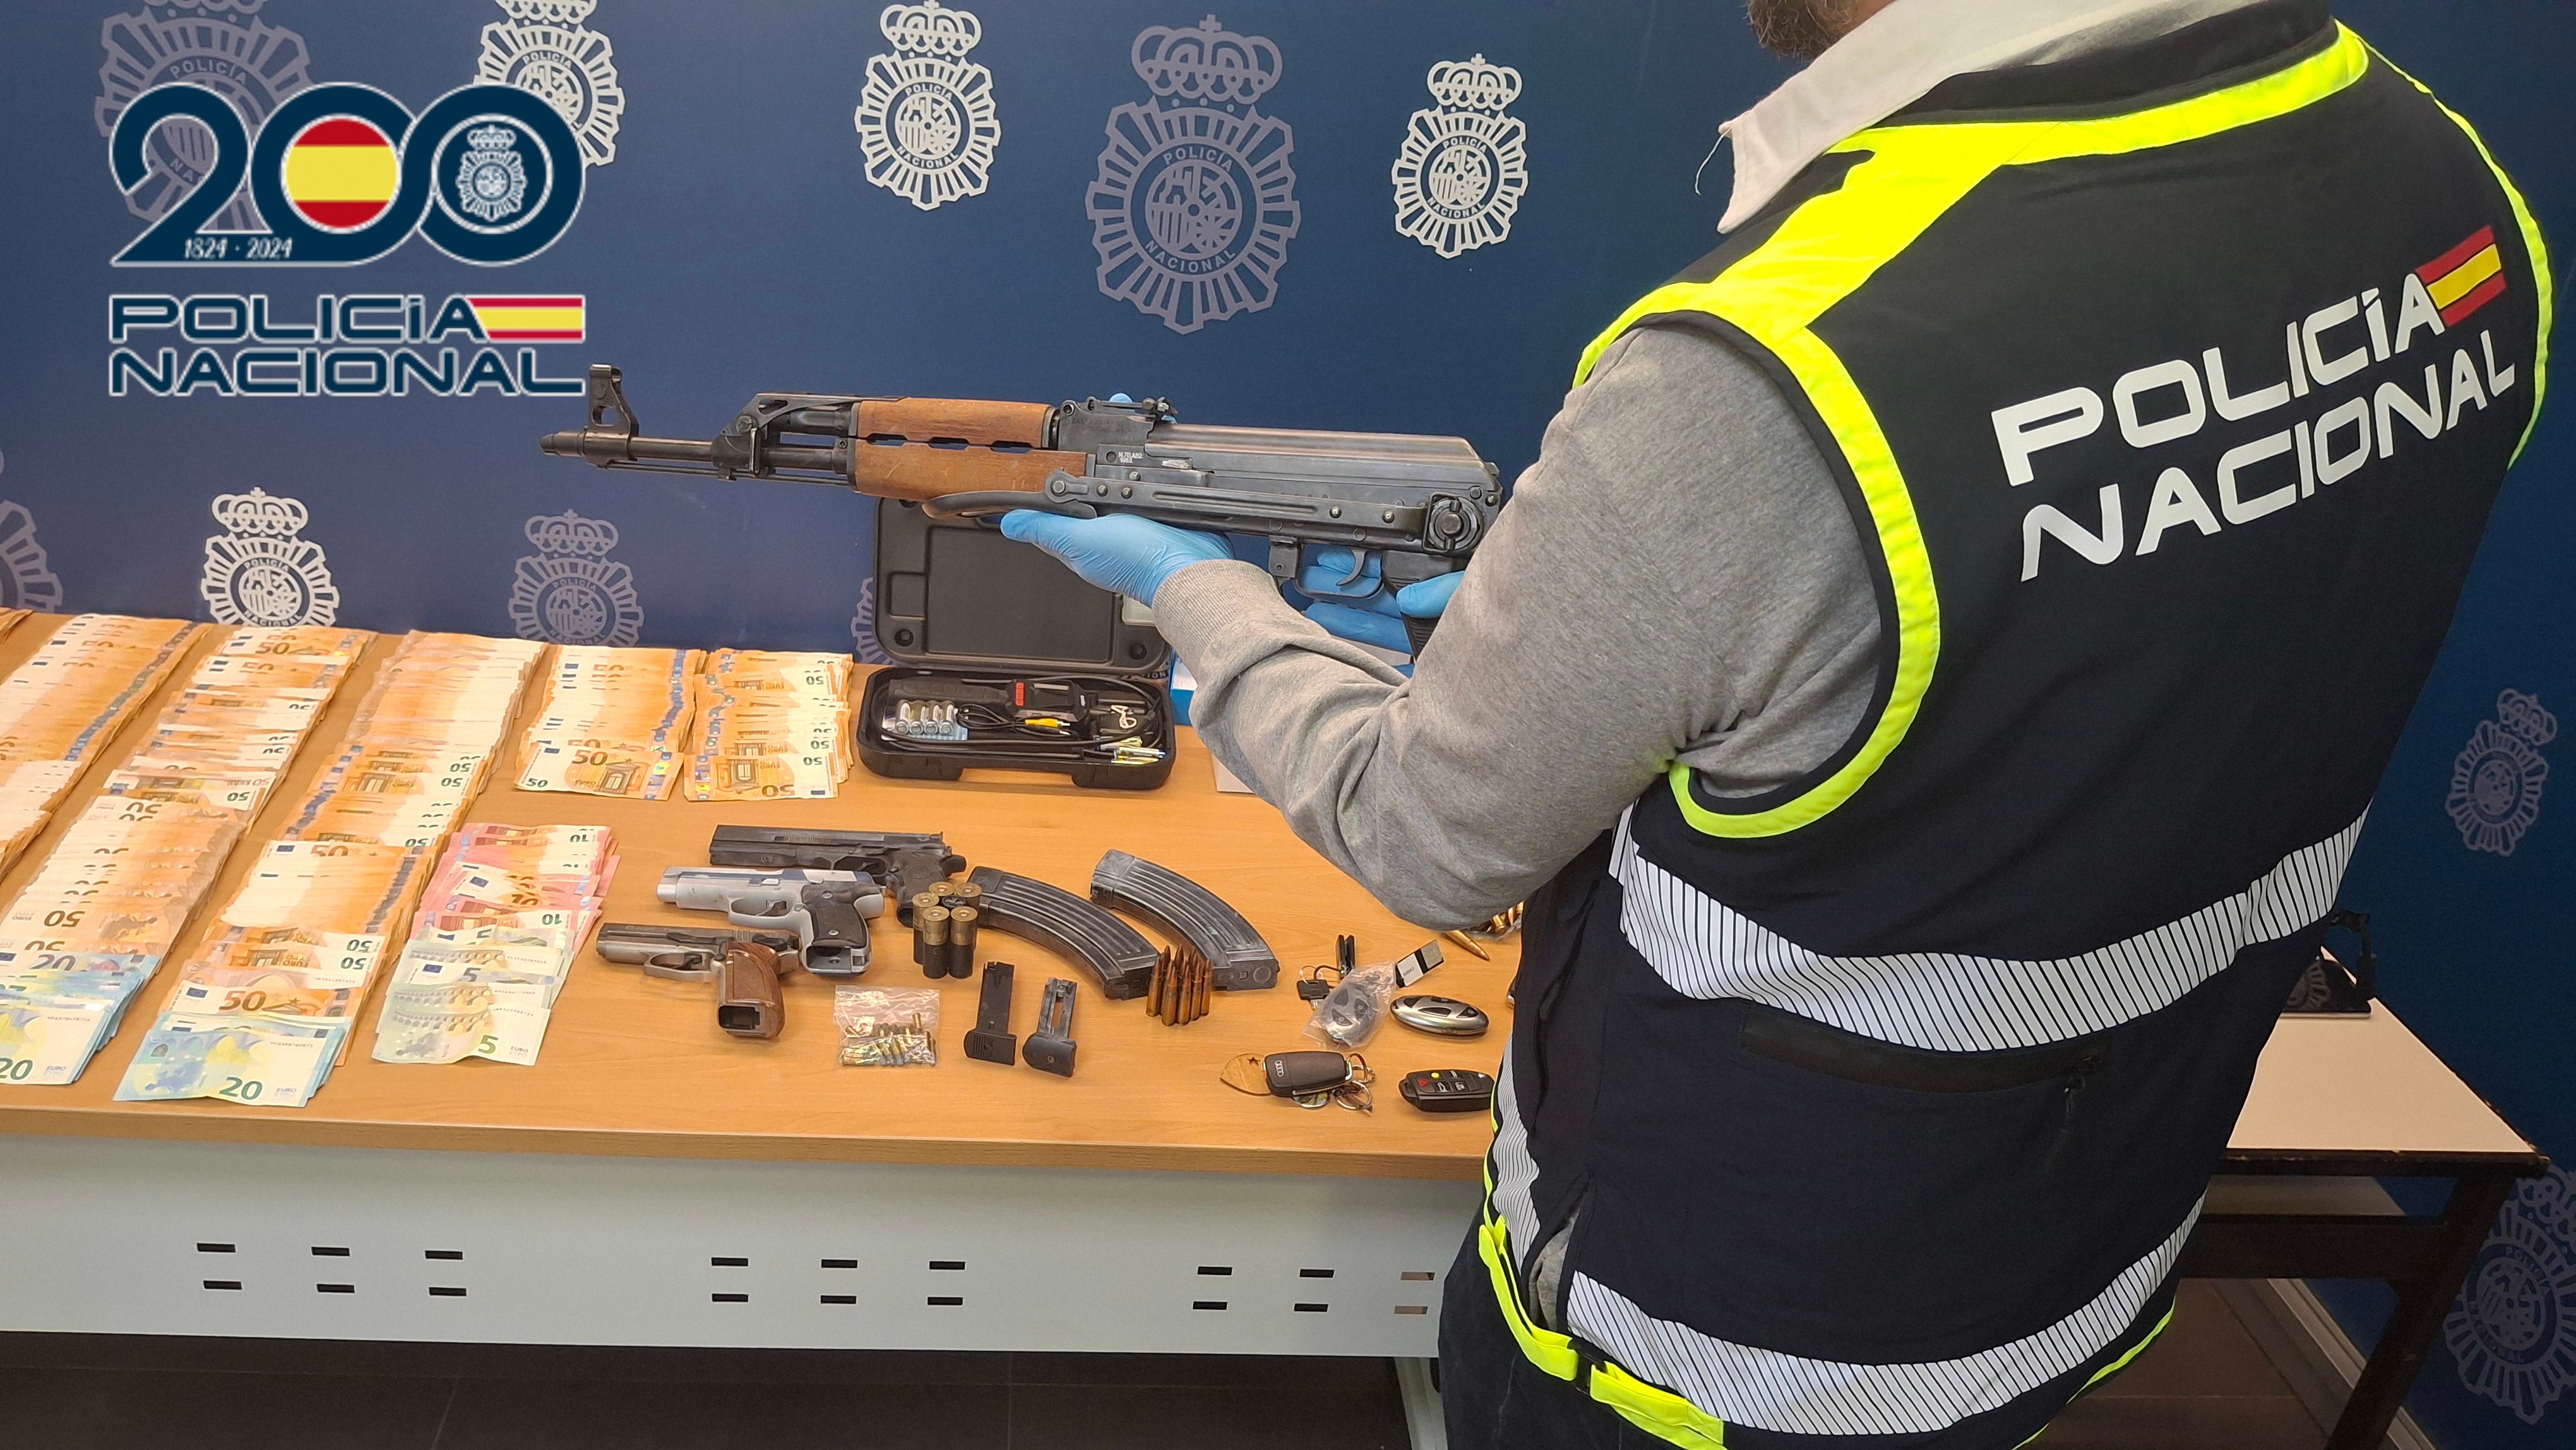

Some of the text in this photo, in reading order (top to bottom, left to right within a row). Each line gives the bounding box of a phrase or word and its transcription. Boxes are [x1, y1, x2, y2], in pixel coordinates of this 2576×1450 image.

[896, 145, 958, 169] NACIONAL
[1427, 196, 1485, 219] NACIONAL
[1144, 240, 1236, 273] NACIONAL
[1991, 273, 2445, 486] POLICÍA
[2021, 330, 2515, 582] NACIONAL
[255, 642, 290, 655] 50
[806, 676, 824, 685] 50
[811, 740, 830, 750] 50
[571, 750, 608, 765] 50
[803, 757, 822, 766] 50
[450, 763, 472, 772] 50
[441, 777, 463, 787] 50
[526, 778, 549, 788] 50
[227, 791, 250, 802] 50
[761, 784, 796, 798] 50
[405, 838, 428, 848] 50
[44, 910, 86, 927] 50
[542, 913, 563, 925] 10
[347, 939, 373, 952] 50
[340, 957, 367, 971] 50
[463, 967, 481, 982] 5
[218, 990, 267, 1012] 50
[478, 1034, 499, 1055] 5
[0, 1057, 33, 1081] 20
[218, 1076, 263, 1100] 20
